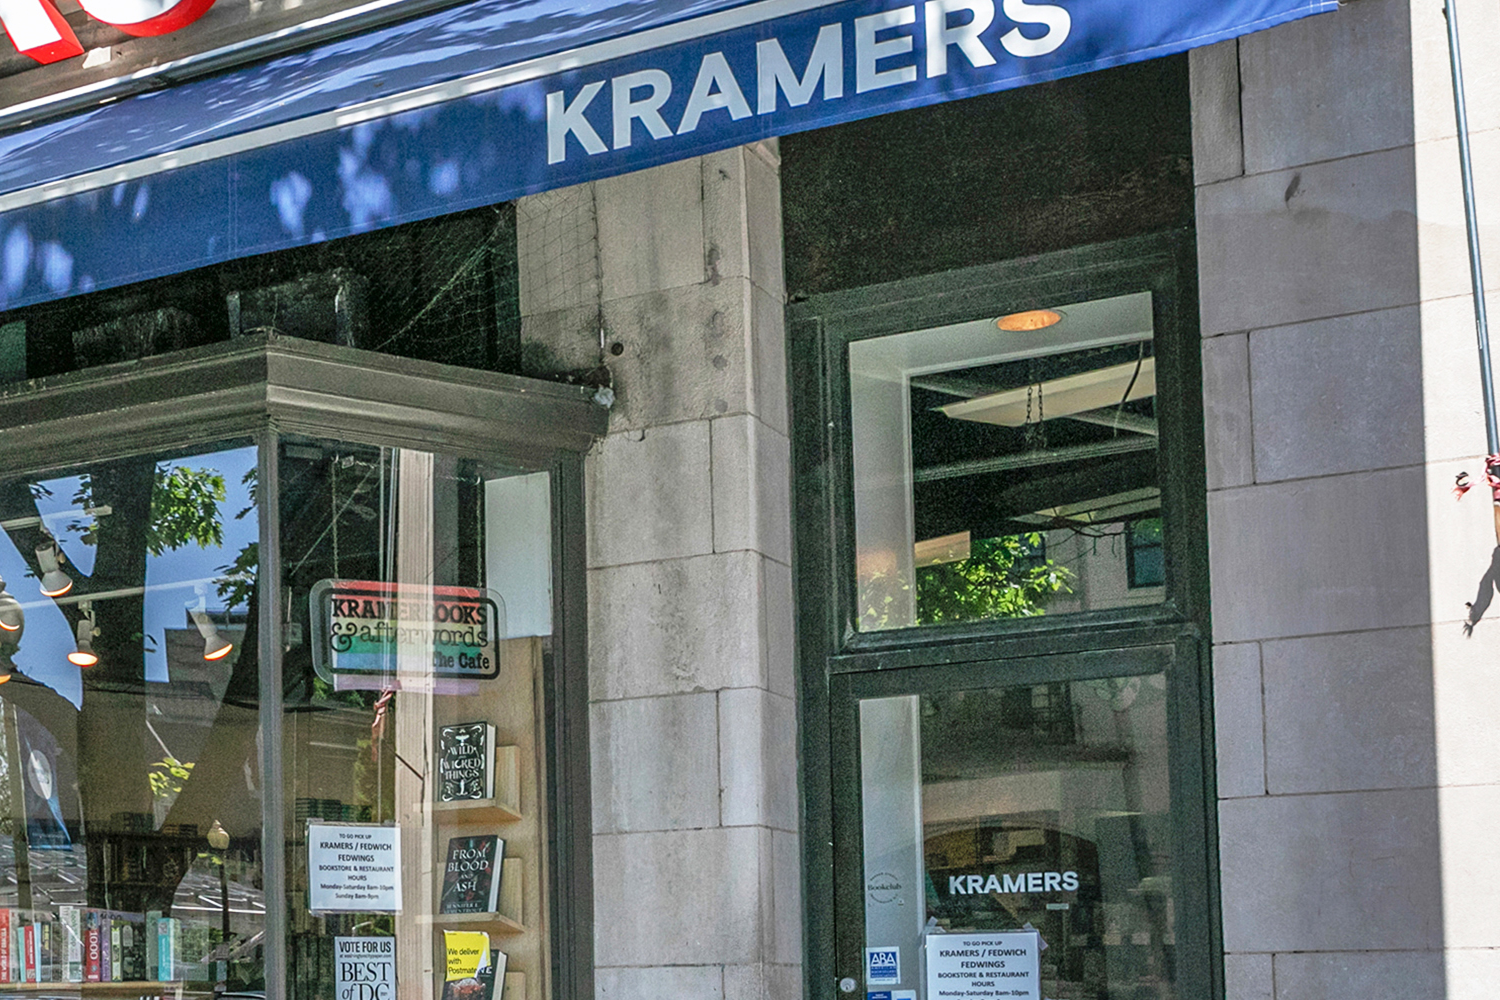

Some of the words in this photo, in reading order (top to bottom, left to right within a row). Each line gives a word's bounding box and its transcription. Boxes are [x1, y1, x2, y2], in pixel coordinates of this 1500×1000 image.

[331, 598, 487, 626] KRAMEROOKS
[330, 621, 358, 652] &
[458, 652, 490, 669] Cafe
[450, 745, 474, 755] WILD
[443, 758, 481, 769] WICKED
[444, 768, 479, 780] THINGS
[320, 842, 354, 850] KRAMERS
[360, 843, 392, 851] FEDWICH
[338, 854, 375, 862] FEDWINGS
[452, 848, 487, 860] FROM
[318, 864, 352, 872] BOOKSTORE
[359, 865, 394, 873] RESTAURANT
[447, 860, 489, 872] BLOOD
[453, 881, 477, 893] ASH
[949, 871, 1079, 895] KRAMERS
[335, 892, 354, 900] Sunday
[89, 931, 98, 960] 1000
[339, 941, 360, 953] VOTE
[362, 941, 378, 953] FOR
[380, 941, 391, 953] US
[459, 948, 479, 956] deliver
[939, 949, 980, 957] KRAMERS
[988, 949, 1027, 957] FEDWICH
[871, 952, 897, 966] ABA
[960, 961, 1006, 969] FEDWINGS
[340, 961, 392, 982] BEST
[448, 966, 477, 974] Postmate
[341, 983, 357, 1000] of
[358, 982, 390, 1000] DC
